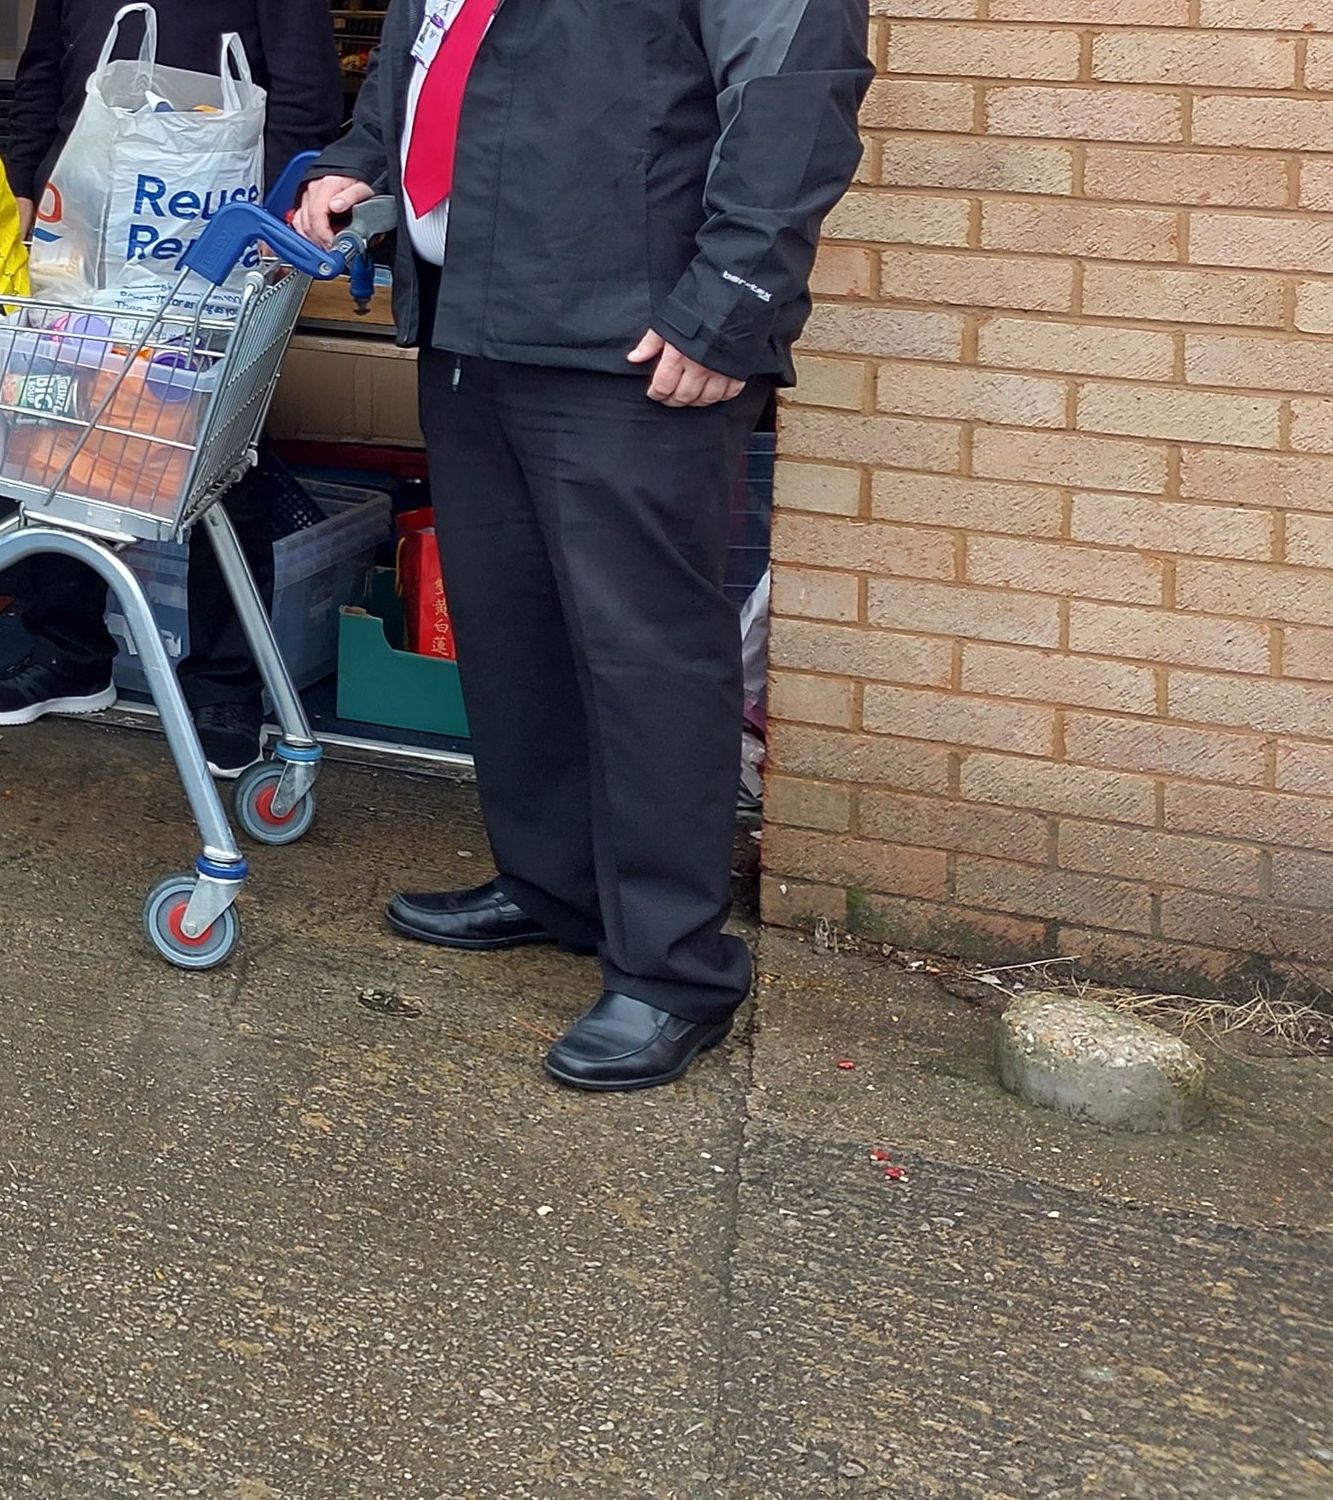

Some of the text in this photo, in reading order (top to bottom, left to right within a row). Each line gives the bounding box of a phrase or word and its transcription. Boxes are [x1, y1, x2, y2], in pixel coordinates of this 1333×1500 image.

[27, 381, 36, 404] SOUP
[34, 377, 53, 409] BIG
[55, 376, 69, 411] HEINZ
